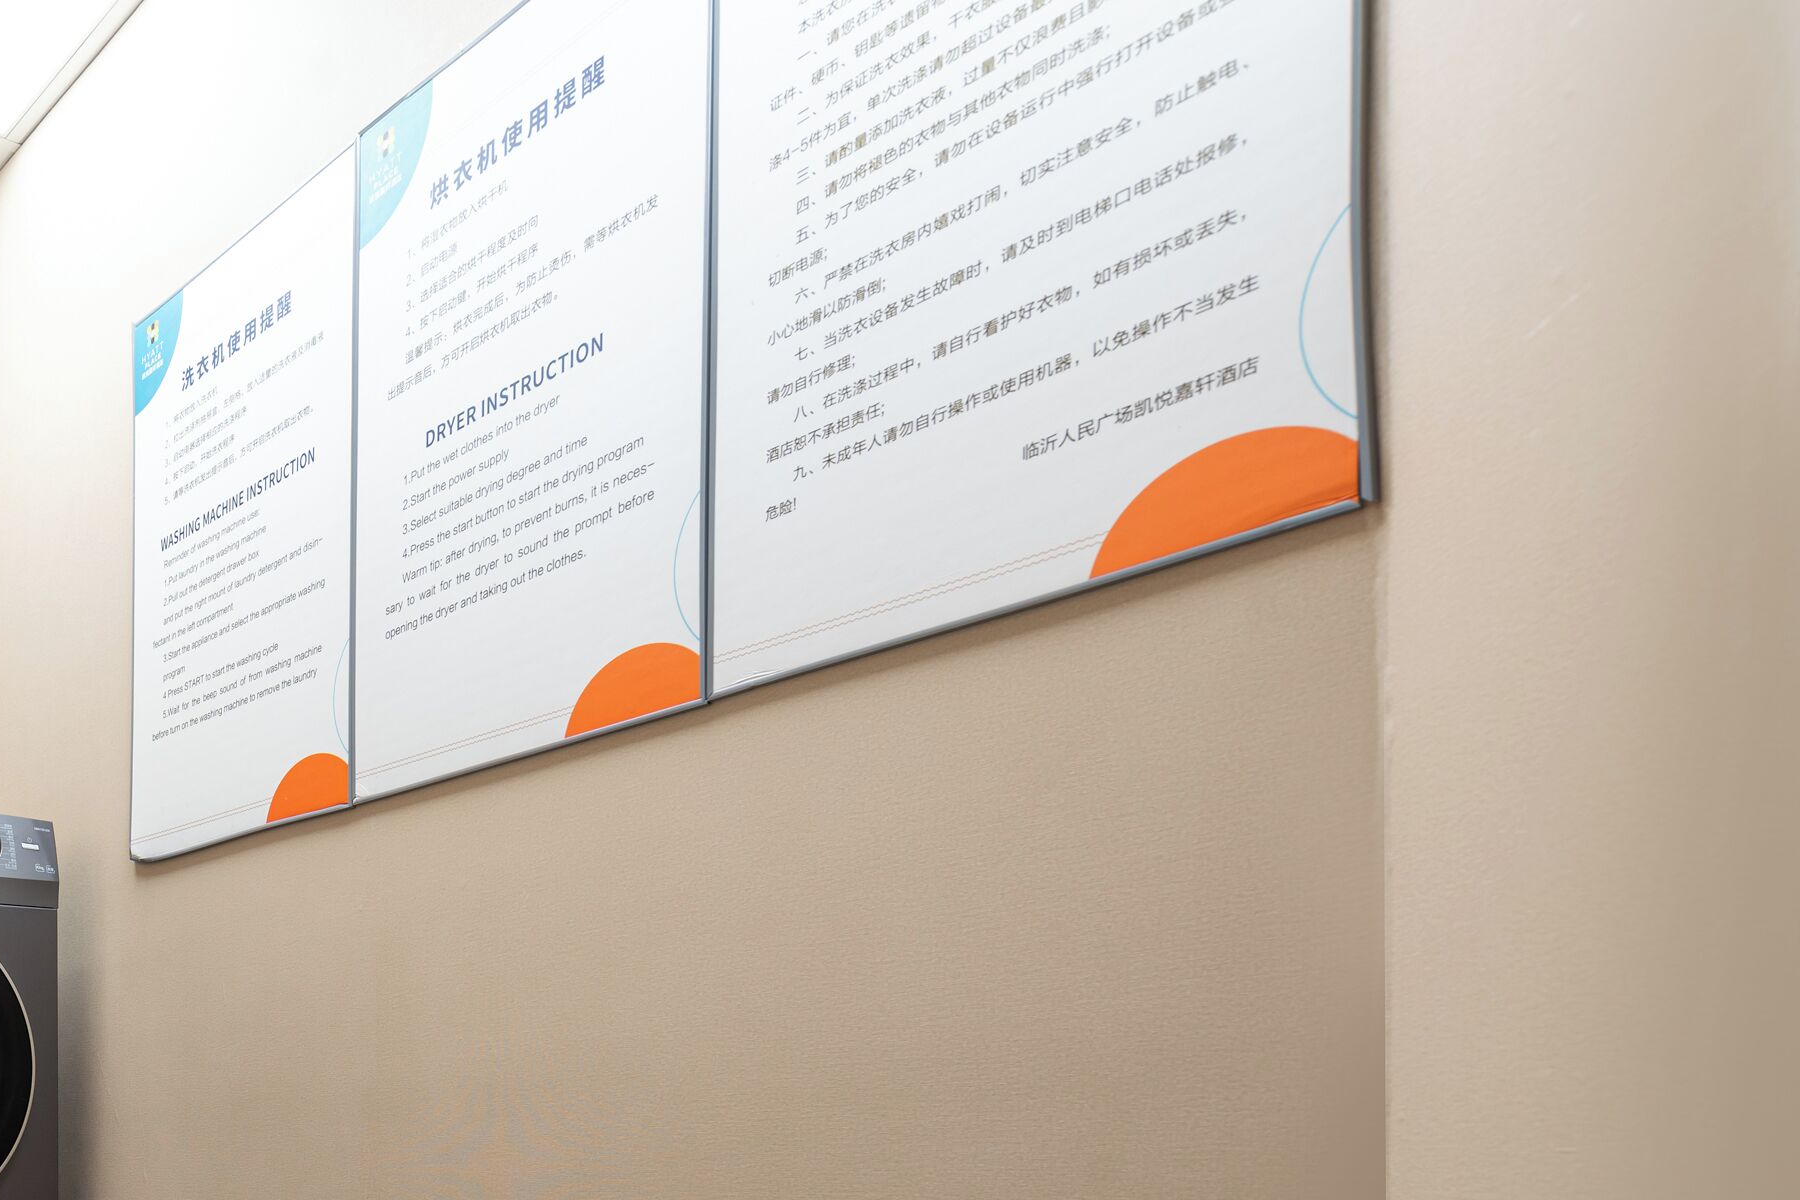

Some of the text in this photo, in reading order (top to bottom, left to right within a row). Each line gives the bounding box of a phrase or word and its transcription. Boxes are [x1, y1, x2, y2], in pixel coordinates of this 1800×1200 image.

[797, 0, 896, 61] 一、请您在洗
[430, 56, 605, 209] 烘衣机使用提醒
[181, 290, 292, 391] 洗衣机使用提醒
[425, 332, 604, 448] DRYER INSTRUCTION
[403, 394, 561, 485] 1.Put the wet clothes into the dryer
[1022, 356, 1259, 460] 临沂人民广场凯悦嘉轩酒店
[160, 447, 315, 552] WASHING MACHINE INSTRUCTION
[401, 436, 644, 559] 4.Press the start button to start the drying program
[402, 448, 510, 511] 2.Start the power supply
[402, 436, 588, 535] 3.Select suitable drying degree and time
[385, 490, 655, 616] sary to wait for the dryer to sound the prompt before
[401, 565, 428, 584] Warm
[429, 558, 443, 572] tip:
[445, 547, 466, 565] after
[467, 533, 500, 554] drying,
[502, 527, 512, 539] to
[514, 506, 552, 536] prevent
[554, 493, 588, 515] burns,
[591, 485, 598, 499] it
[600, 481, 610, 494] is
[384, 549, 587, 640] opening the dryer and taking out the clothes.
